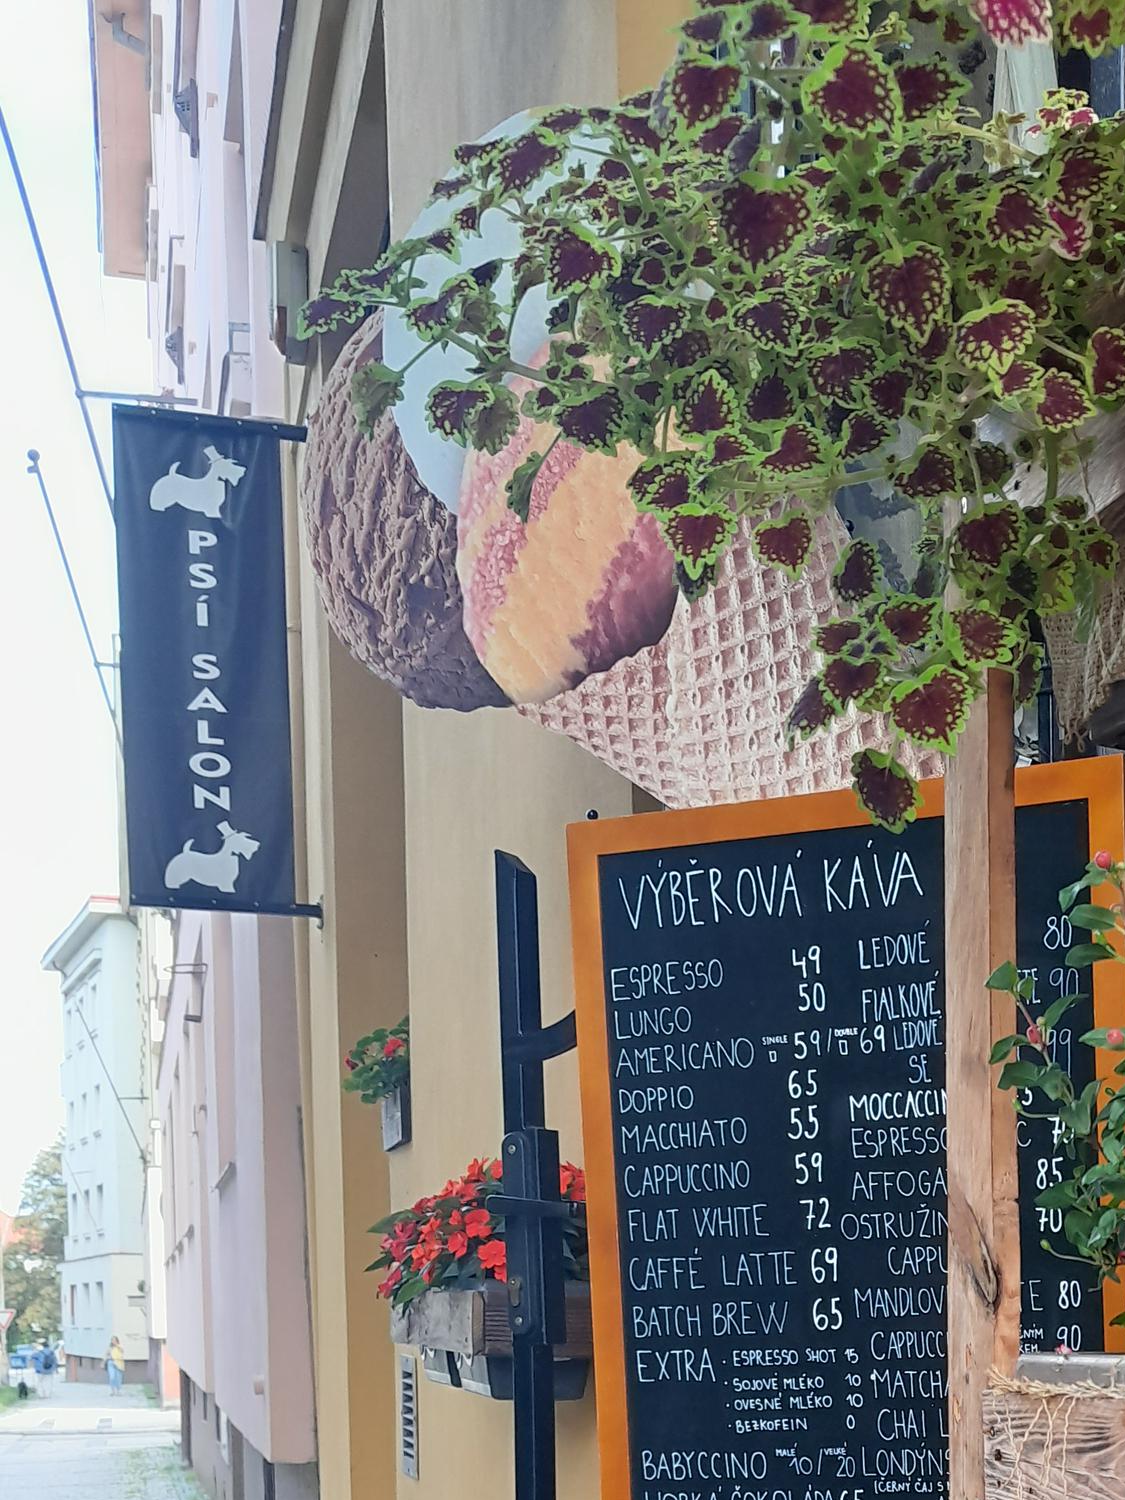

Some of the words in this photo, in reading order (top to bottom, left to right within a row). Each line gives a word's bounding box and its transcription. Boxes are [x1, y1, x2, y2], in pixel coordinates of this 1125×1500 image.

[187, 529, 219, 627] PSÍ
[187, 653, 231, 811] SALON
[618, 849, 802, 930] VÝBĚROVÁ
[824, 840, 924, 912] KÁVA
[858, 919, 930, 970] LEDOVÉ
[1043, 915, 1072, 950] 80
[611, 959, 723, 1001] ESPRESSO
[792, 945, 820, 978] 49
[615, 1006, 692, 1039] LUNGO
[798, 982, 825, 1012] 50
[862, 970, 942, 1023] FIALKOVÉ
[1050, 967, 1079, 1007] 90
[616, 1038, 754, 1077] AMERICANO
[761, 1034, 788, 1045] SINGLE
[794, 1030, 821, 1060] 59
[834, 1027, 858, 1037] DOUBLE
[860, 1025, 885, 1053] 69
[893, 1014, 943, 1051] LEDOVÉ
[909, 1054, 932, 1083] SE
[619, 1085, 694, 1113] DOPPIO
[788, 1069, 817, 1098] 65
[621, 1117, 747, 1154] MACCHIATO
[787, 1105, 819, 1139] 55
[624, 1160, 750, 1197] CAPPUCCINO
[795, 1152, 822, 1184] 59
[852, 1167, 949, 1201] AFFOGA
[628, 1209, 679, 1241] FLAT
[692, 1204, 769, 1238] WHITE
[799, 1197, 831, 1230] 72
[1035, 1207, 1062, 1233] 70
[629, 1248, 705, 1290] CAFFÉ
[722, 1251, 797, 1285] LATTE
[811, 1247, 837, 1283] 69
[633, 1305, 701, 1337] BATCH
[712, 1301, 788, 1336] BREW
[813, 1297, 842, 1330] 65
[854, 1285, 948, 1318] MANDLOV
[1058, 1280, 1081, 1309] 80
[871, 1331, 948, 1361] CAPPUCC
[1056, 1324, 1081, 1351] 90
[636, 1348, 716, 1382] EXTRA
[733, 1350, 798, 1367] ESPRESSO
[805, 1348, 836, 1363] SHOT
[844, 1348, 859, 1364] 15
[733, 1373, 778, 1391] SOJOVÉ
[783, 1373, 824, 1390] MLÉKO
[845, 1373, 861, 1387] 10
[734, 1392, 782, 1411] OVESNÉ
[789, 1392, 832, 1409] MLÉKO
[846, 1393, 863, 1408] 10
[736, 1417, 807, 1433] BEZKOFEIN
[846, 1415, 856, 1429] 0
[877, 1408, 927, 1441] CHAI
[642, 1450, 767, 1480] BABYCCINO
[775, 1442, 797, 1457] MALÉ
[789, 1457, 813, 1476] 10
[823, 1441, 847, 1456] VELKÉ
[836, 1456, 856, 1478] 20
[914, 1478, 933, 1493] ČAJ
[937, 1481, 944, 1492] S
